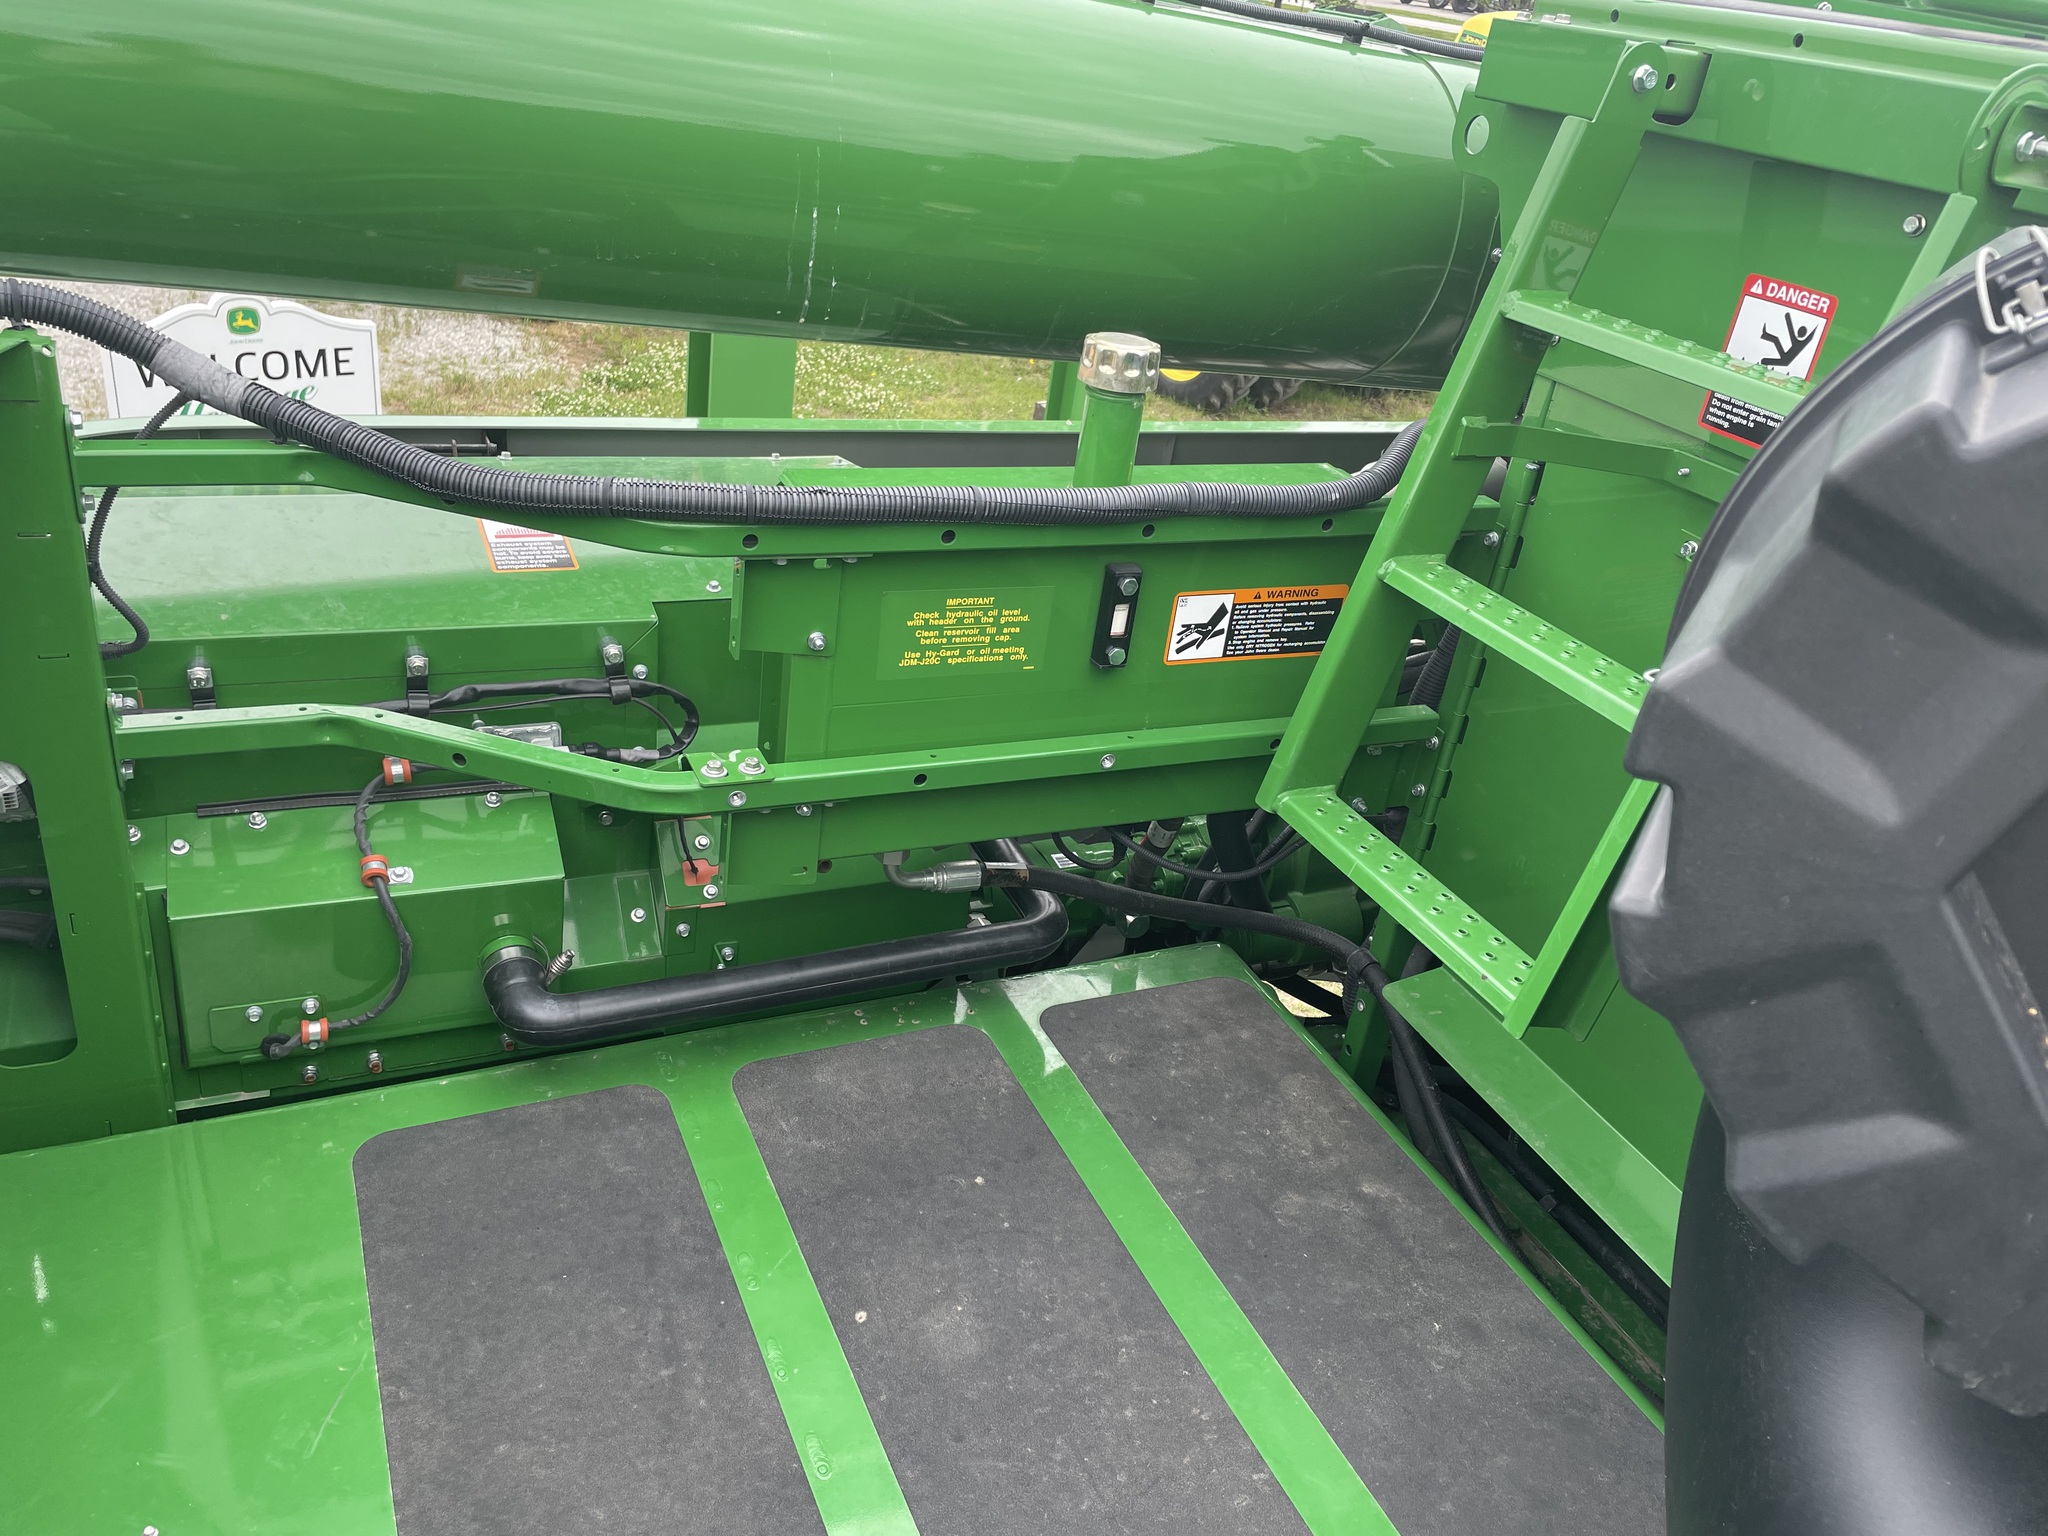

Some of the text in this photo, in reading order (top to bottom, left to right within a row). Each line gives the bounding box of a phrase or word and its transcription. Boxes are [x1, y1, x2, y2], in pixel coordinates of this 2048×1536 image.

[1766, 282, 1830, 314] DANGER
[134, 347, 354, 389] COME
[1709, 406, 1726, 418] when
[1726, 413, 1747, 425] engine
[1712, 398, 1720, 406] Do
[1732, 407, 1750, 416] enter
[1749, 413, 1766, 424] grain
[1706, 414, 1730, 428] running.
[1267, 588, 1319, 599] WARNING
[946, 597, 996, 606] IMPORTANT
[946, 610, 984, 619] hydraulic
[1000, 614, 1030, 624] ground.
[944, 628, 980, 636] reservoir
[926, 649, 960, 658] Hy-Gard
[992, 646, 1024, 654] meeting
[898, 653, 1028, 666] JDM-J20C specifications only.
